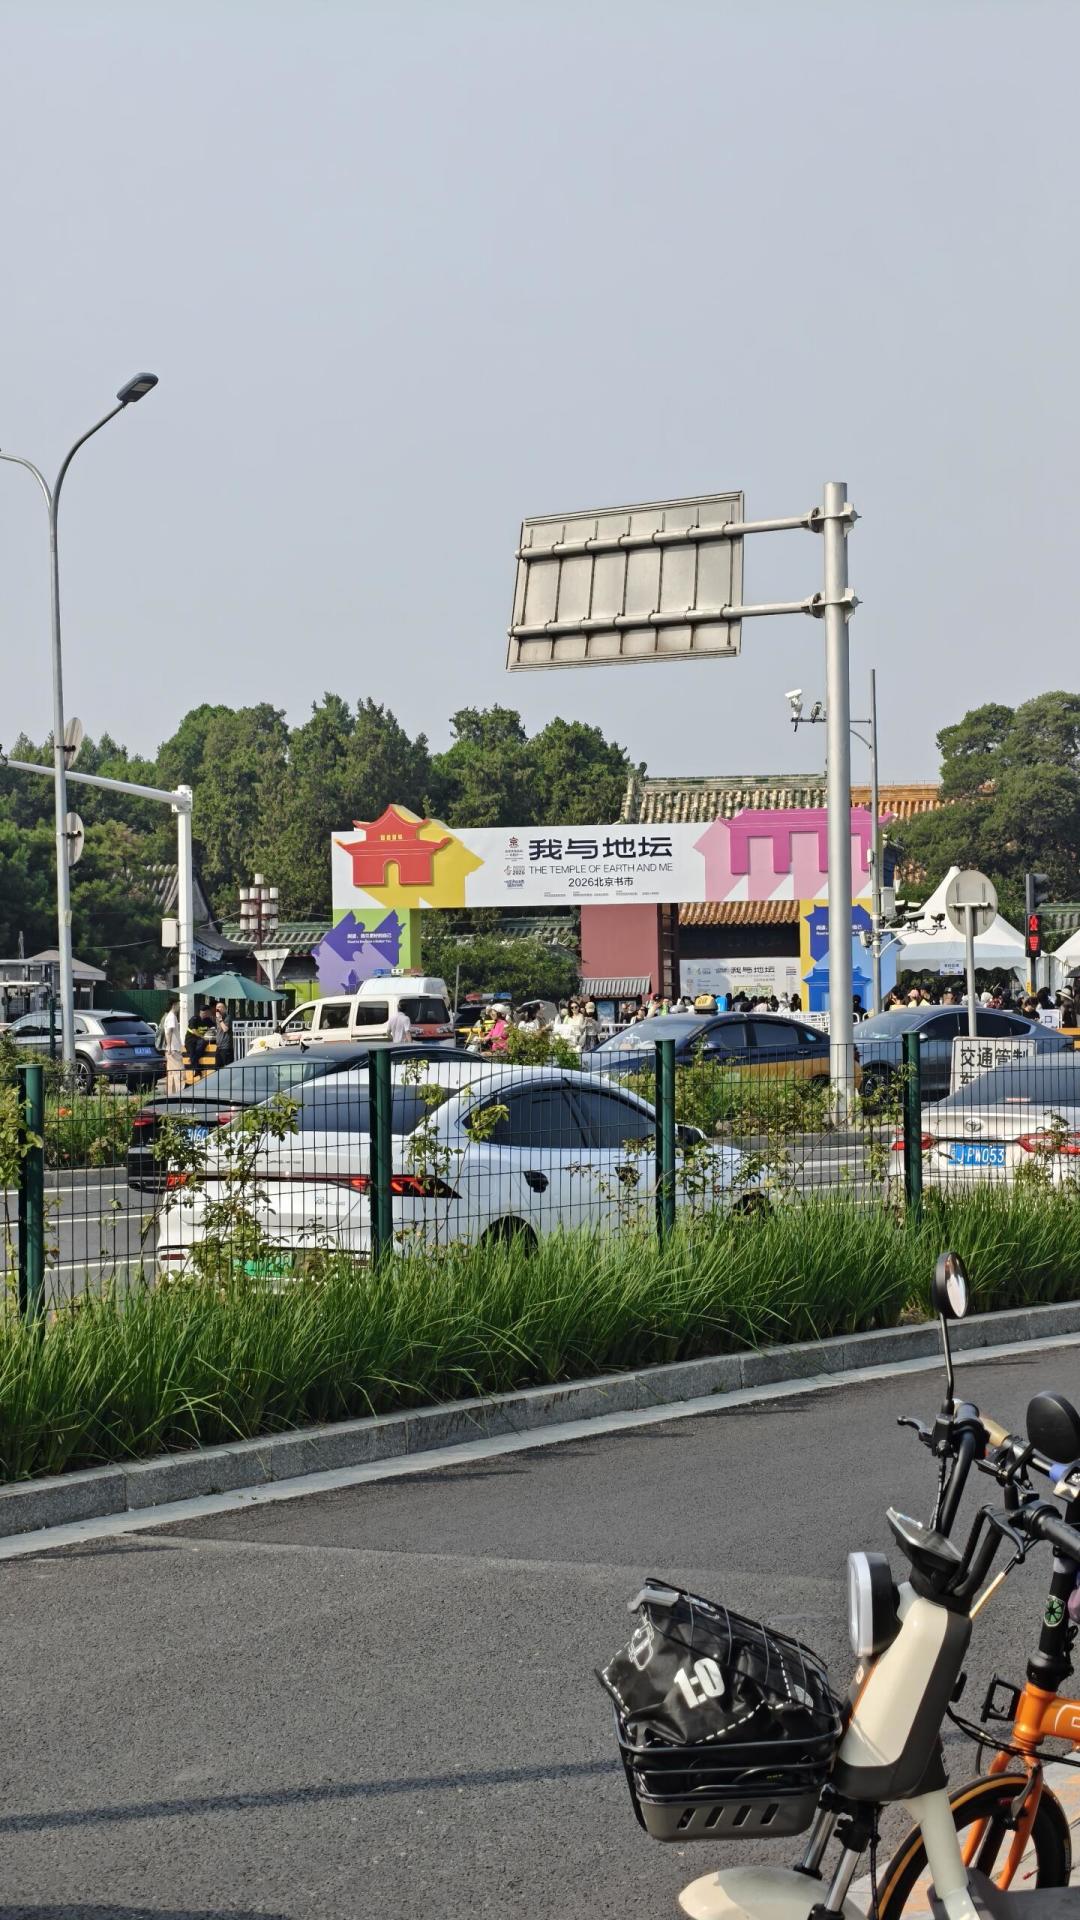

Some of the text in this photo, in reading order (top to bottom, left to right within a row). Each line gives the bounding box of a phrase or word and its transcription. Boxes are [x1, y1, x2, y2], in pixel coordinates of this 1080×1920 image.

[529, 836, 673, 860] 我与地坛
[529, 863, 547, 874] THE
[549, 864, 586, 874] TEMPLE
[588, 864, 601, 873] OF
[604, 863, 635, 873] EARTH
[636, 863, 657, 872] AND
[659, 862, 674, 872] ME
[569, 877, 634, 888] 2026北京书市
[674, 1657, 725, 1709] 1:0
